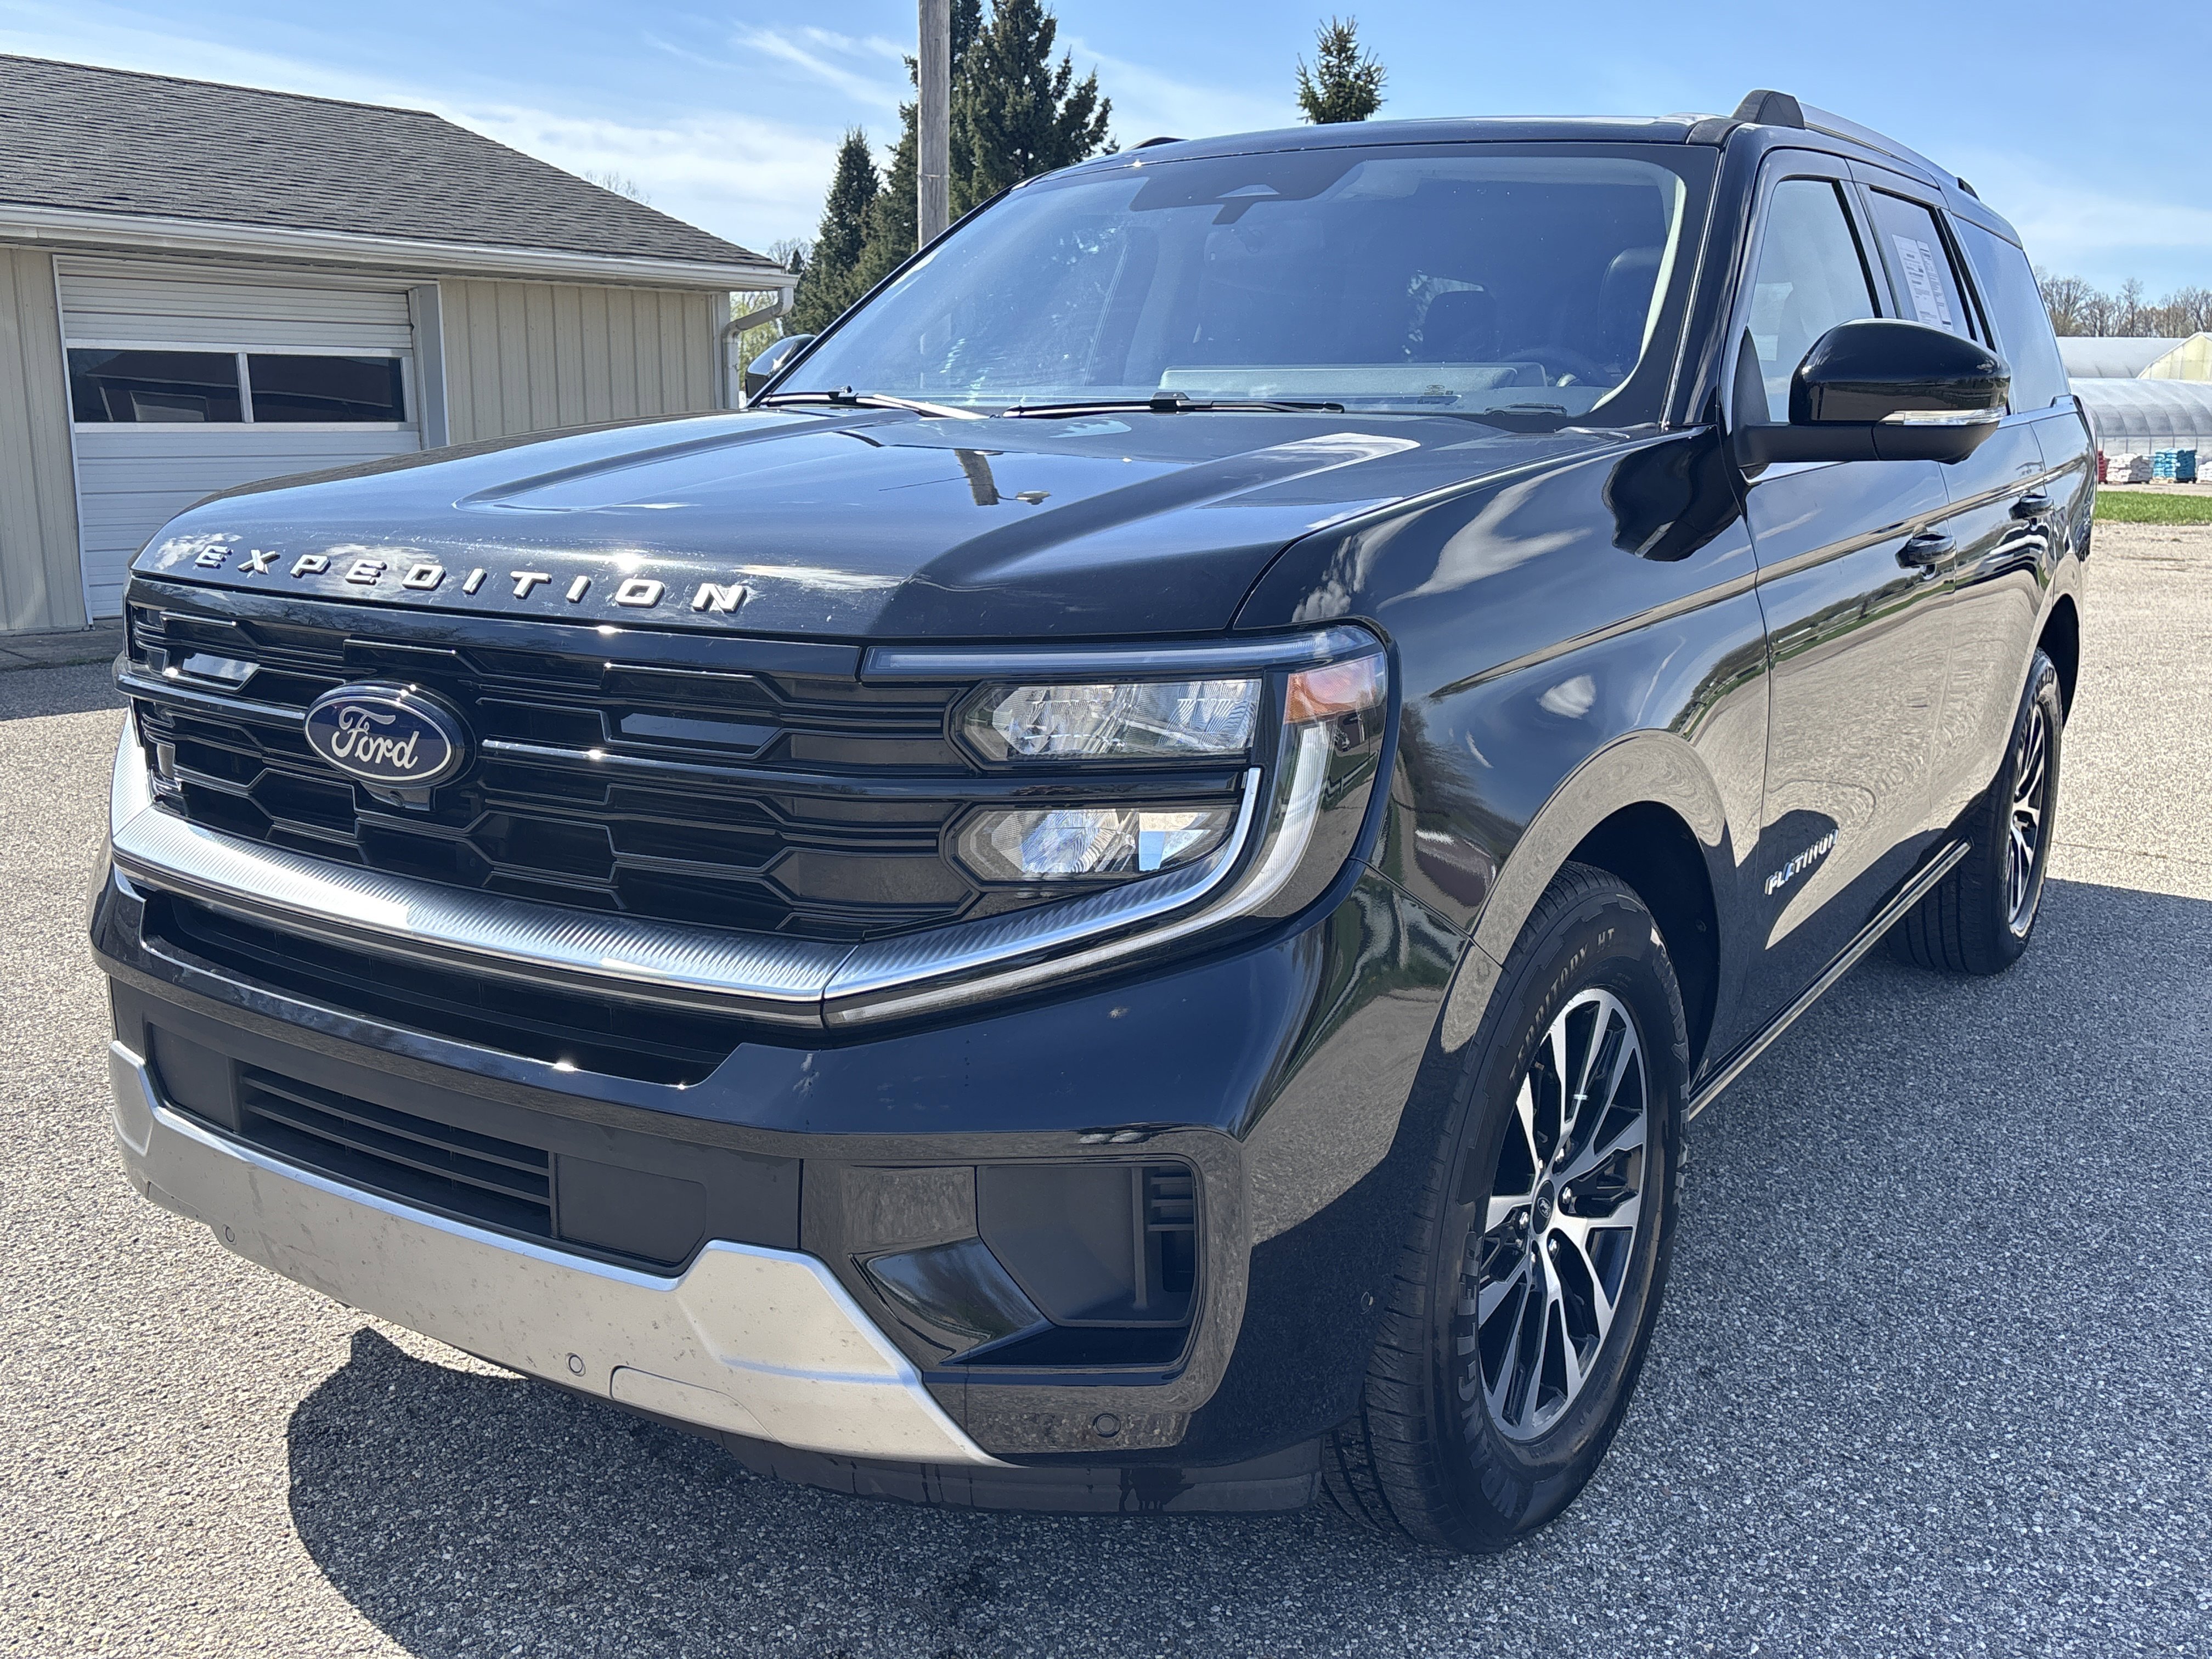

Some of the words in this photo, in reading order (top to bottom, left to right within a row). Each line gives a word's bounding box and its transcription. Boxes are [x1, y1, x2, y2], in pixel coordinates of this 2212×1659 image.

[195, 545, 747, 613] EXPEDITION
[331, 706, 420, 769] Ford
[1765, 829, 1839, 895] PLATINUM
[1597, 928, 1615, 952] HT
